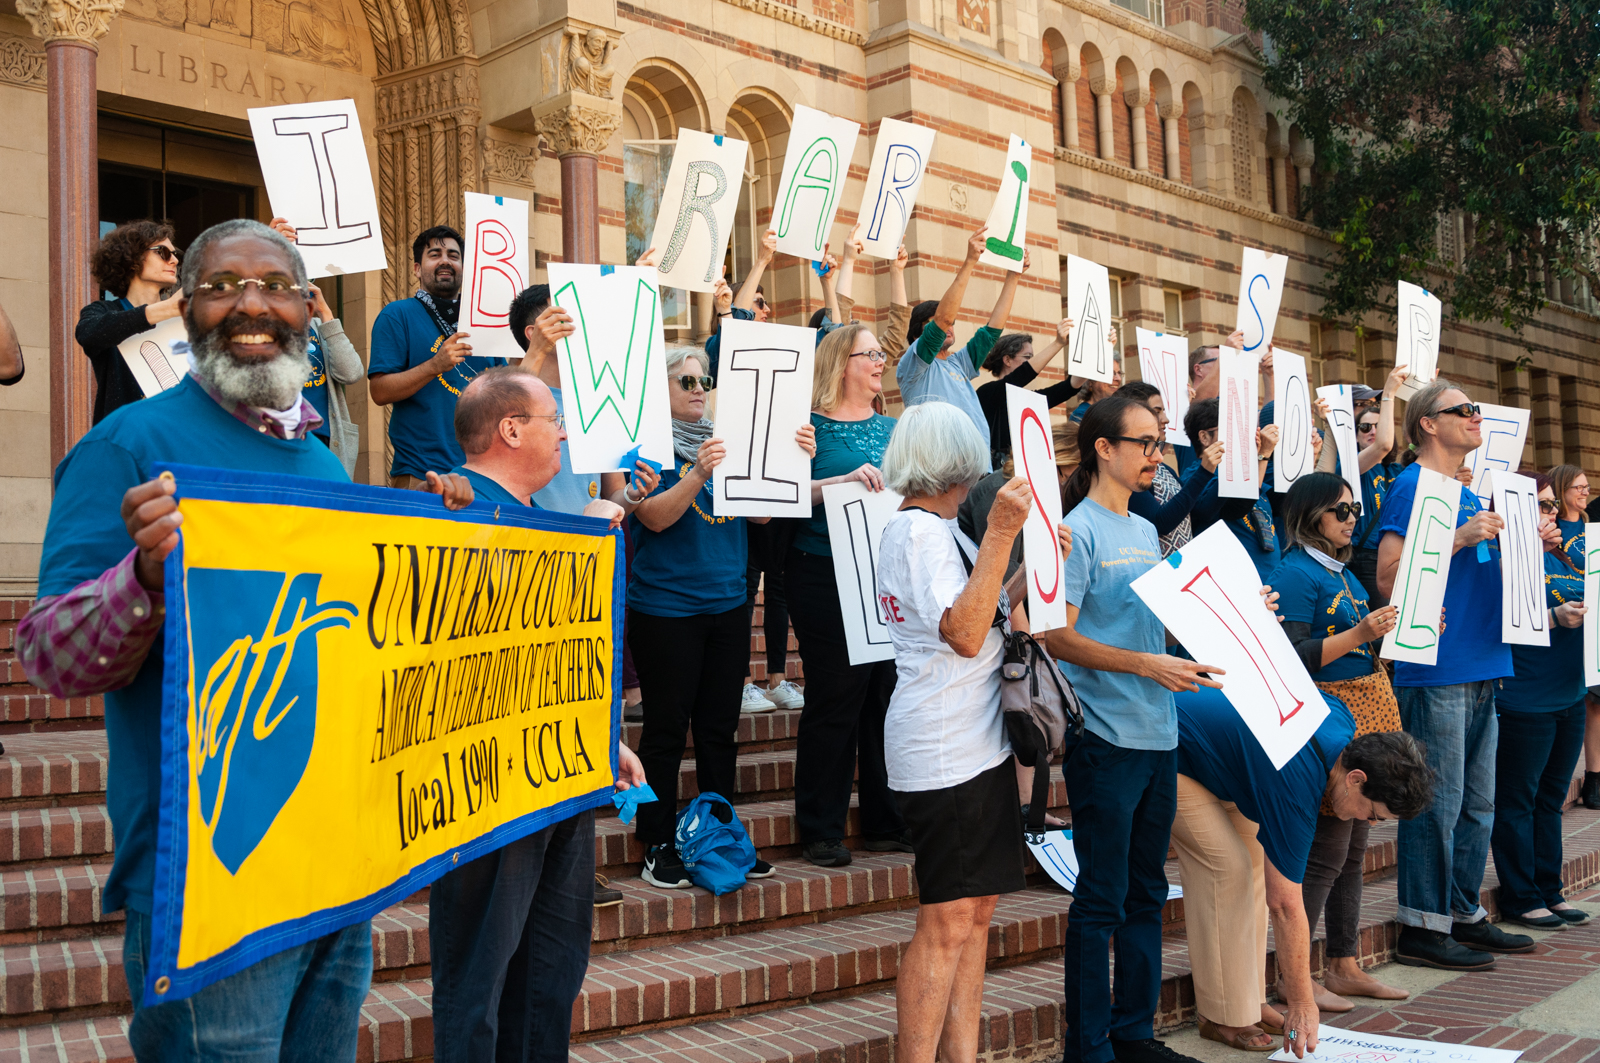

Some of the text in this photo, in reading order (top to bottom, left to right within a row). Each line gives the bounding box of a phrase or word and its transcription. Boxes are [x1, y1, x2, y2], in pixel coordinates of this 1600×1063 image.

[130, 44, 317, 104] LIBRARY
[272, 113, 372, 246] I
[658, 160, 728, 283] R
[778, 136, 839, 251] A
[867, 144, 922, 248] R
[470, 219, 524, 328] B
[1241, 273, 1270, 352] S
[554, 278, 657, 443] W
[1072, 282, 1106, 375] A
[1402, 303, 1434, 391] R
[437, 373, 463, 398] iversity
[724, 348, 800, 504] I
[1142, 347, 1178, 431] N
[1225, 376, 1250, 482] N
[1281, 375, 1308, 483] O
[691, 499, 716, 525] iversity
[1020, 407, 1059, 604] S
[367, 543, 603, 650] UNIVERSITY COUNCIL
[1101, 557, 1129, 568] Powering
[1394, 496, 1453, 650] E
[1504, 489, 1544, 632] N
[444, 643, 525, 734] FEDERATION
[519, 642, 544, 714] OF
[536, 636, 606, 709] TEACHERS
[1180, 566, 1304, 727] I
[396, 716, 595, 851] local 1990 UCLA
